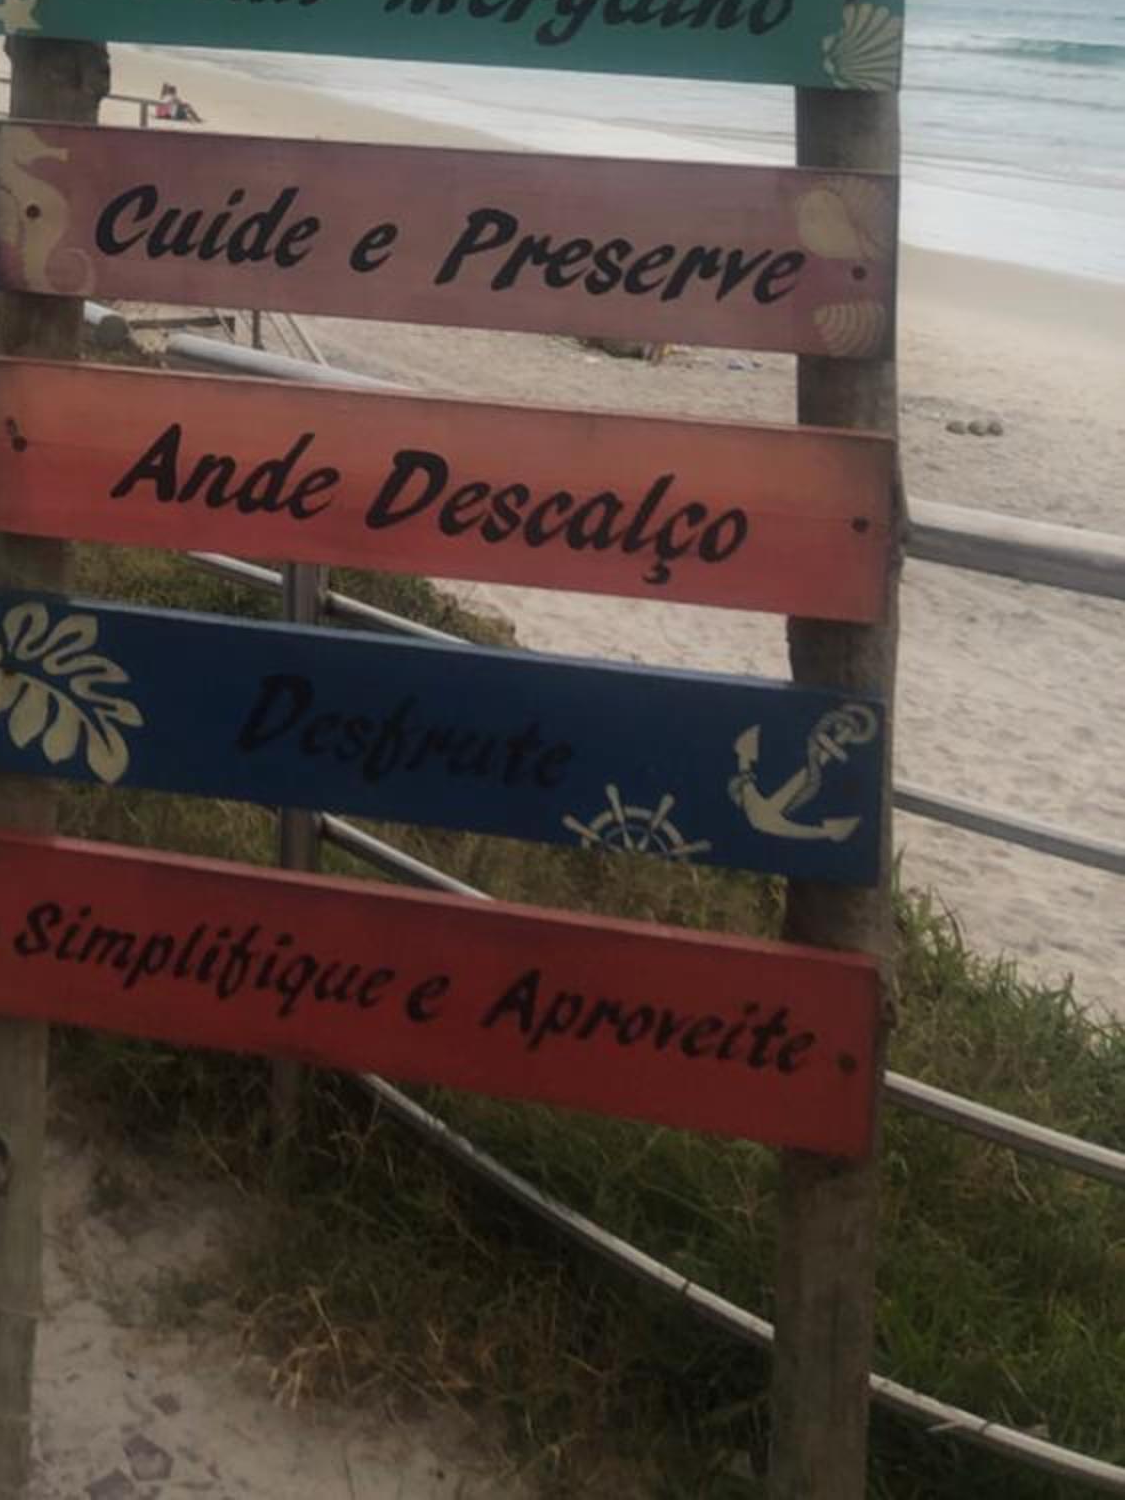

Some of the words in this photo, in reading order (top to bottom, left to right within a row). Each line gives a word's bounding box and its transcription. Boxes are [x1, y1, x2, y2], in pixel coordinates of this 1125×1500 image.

[96, 184, 322, 269] Cuide
[349, 220, 398, 273] e
[434, 209, 807, 303] Preserve
[112, 425, 339, 514] Ande
[366, 451, 748, 584] Descalço
[237, 675, 577, 789] Desfrute
[14, 903, 393, 1017] Simplifique
[405, 971, 451, 1021] e
[481, 968, 815, 1074] Aproveite
